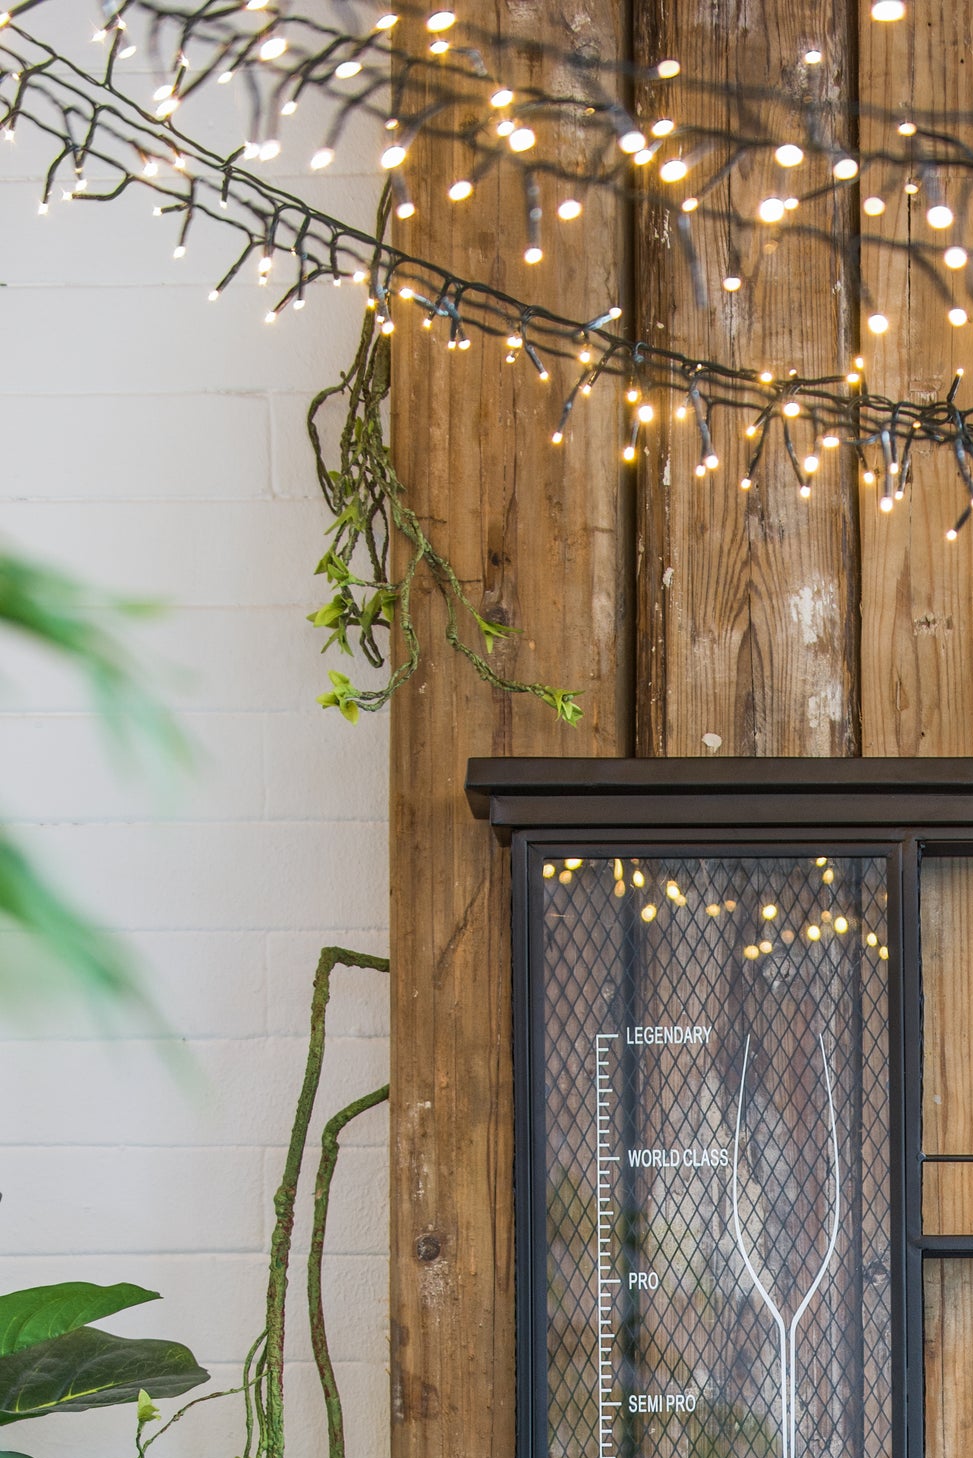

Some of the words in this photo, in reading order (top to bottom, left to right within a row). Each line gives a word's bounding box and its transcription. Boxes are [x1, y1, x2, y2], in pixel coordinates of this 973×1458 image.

[627, 1026, 712, 1044] LEGENDARY
[628, 1150, 680, 1168] WORLD
[683, 1149, 729, 1167] CLASS
[628, 1273, 659, 1290] PRO
[628, 1395, 662, 1413] SEMI
[666, 1395, 697, 1412] PRO
